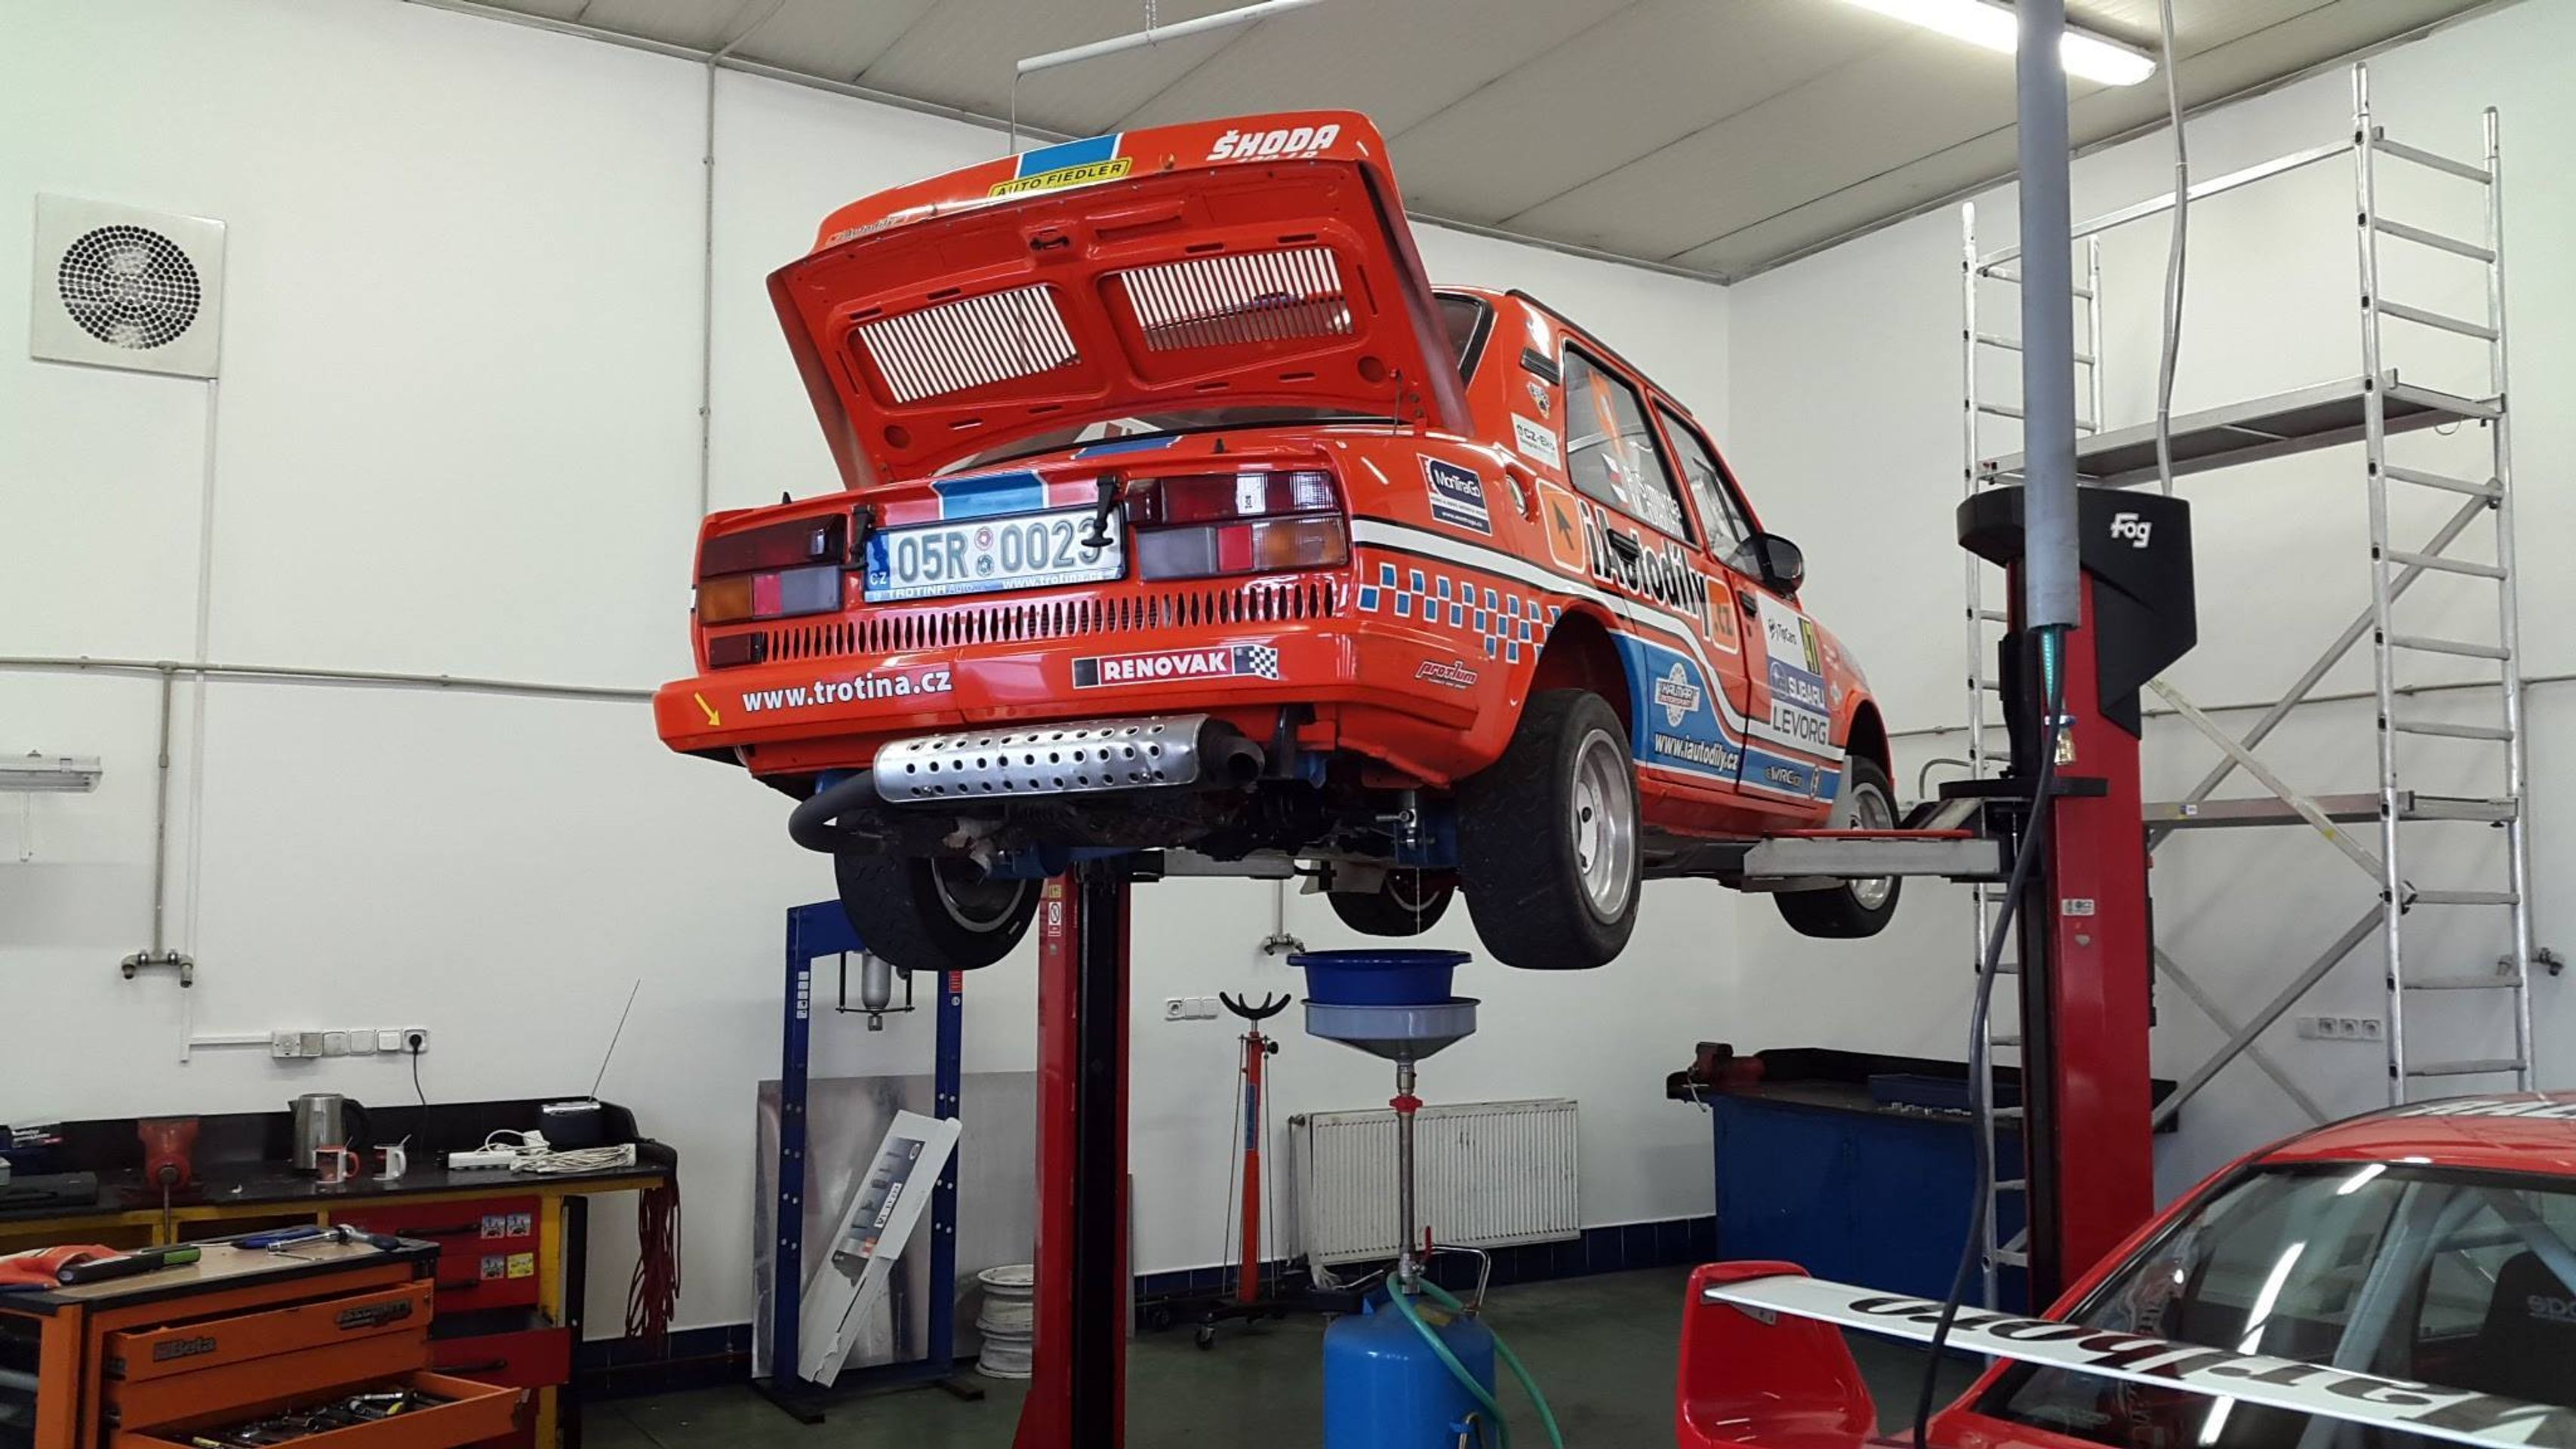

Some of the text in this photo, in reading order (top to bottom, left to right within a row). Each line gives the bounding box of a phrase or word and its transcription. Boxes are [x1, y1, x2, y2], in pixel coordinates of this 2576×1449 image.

[1206, 124, 1341, 162] ŠKODA
[997, 163, 1122, 197] AUTO FIEDLER
[2110, 512, 2153, 549] Fog
[897, 517, 1103, 583] 05R 0023
[869, 571, 888, 586] CZ
[1103, 651, 1227, 681] RENOVAK
[742, 672, 953, 712] www.trotina.cz
[1787, 676, 1827, 709] SUBARU
[1773, 705, 1827, 746] LEVORG
